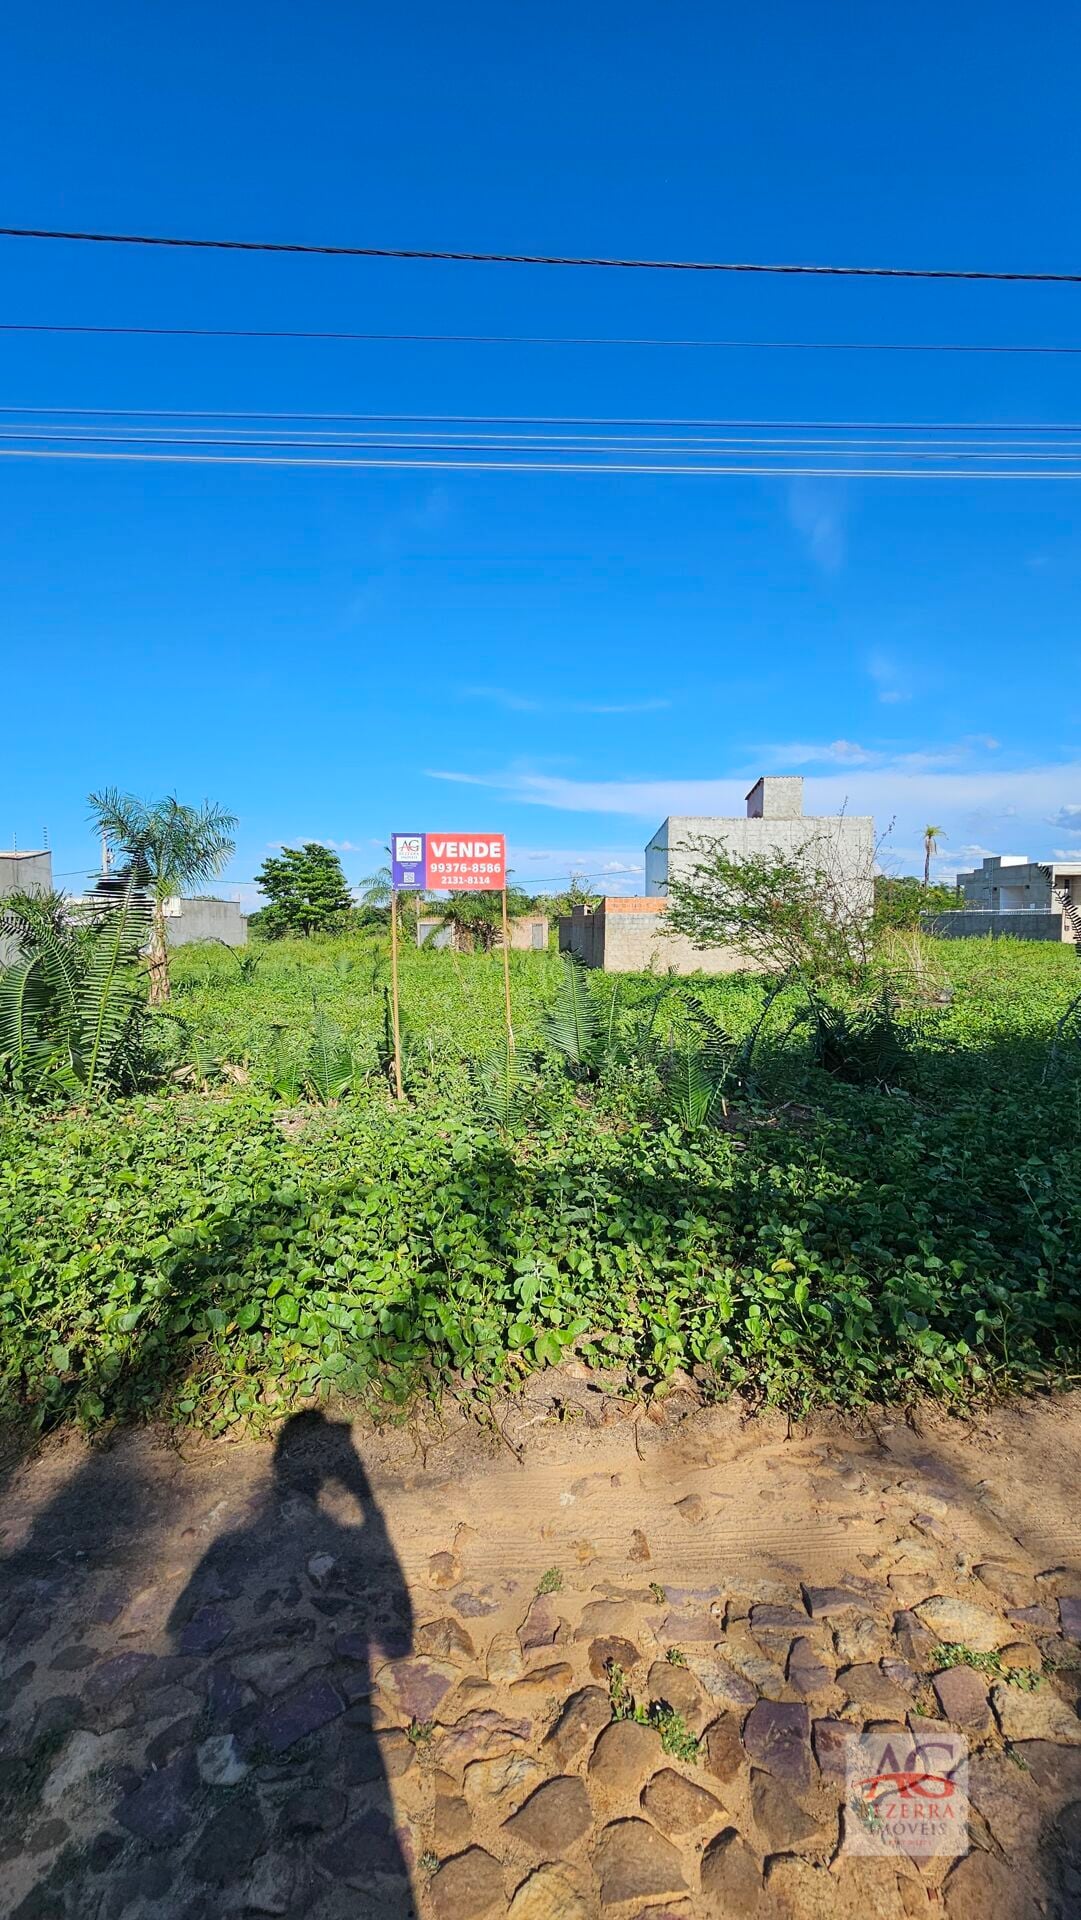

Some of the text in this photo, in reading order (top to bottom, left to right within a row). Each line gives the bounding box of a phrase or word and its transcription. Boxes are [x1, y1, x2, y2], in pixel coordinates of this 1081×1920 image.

[399, 840, 419, 851] AG
[430, 842, 501, 858] VENDE
[430, 863, 501, 873] 99376-8586
[441, 876, 490, 885] 2131-8114
